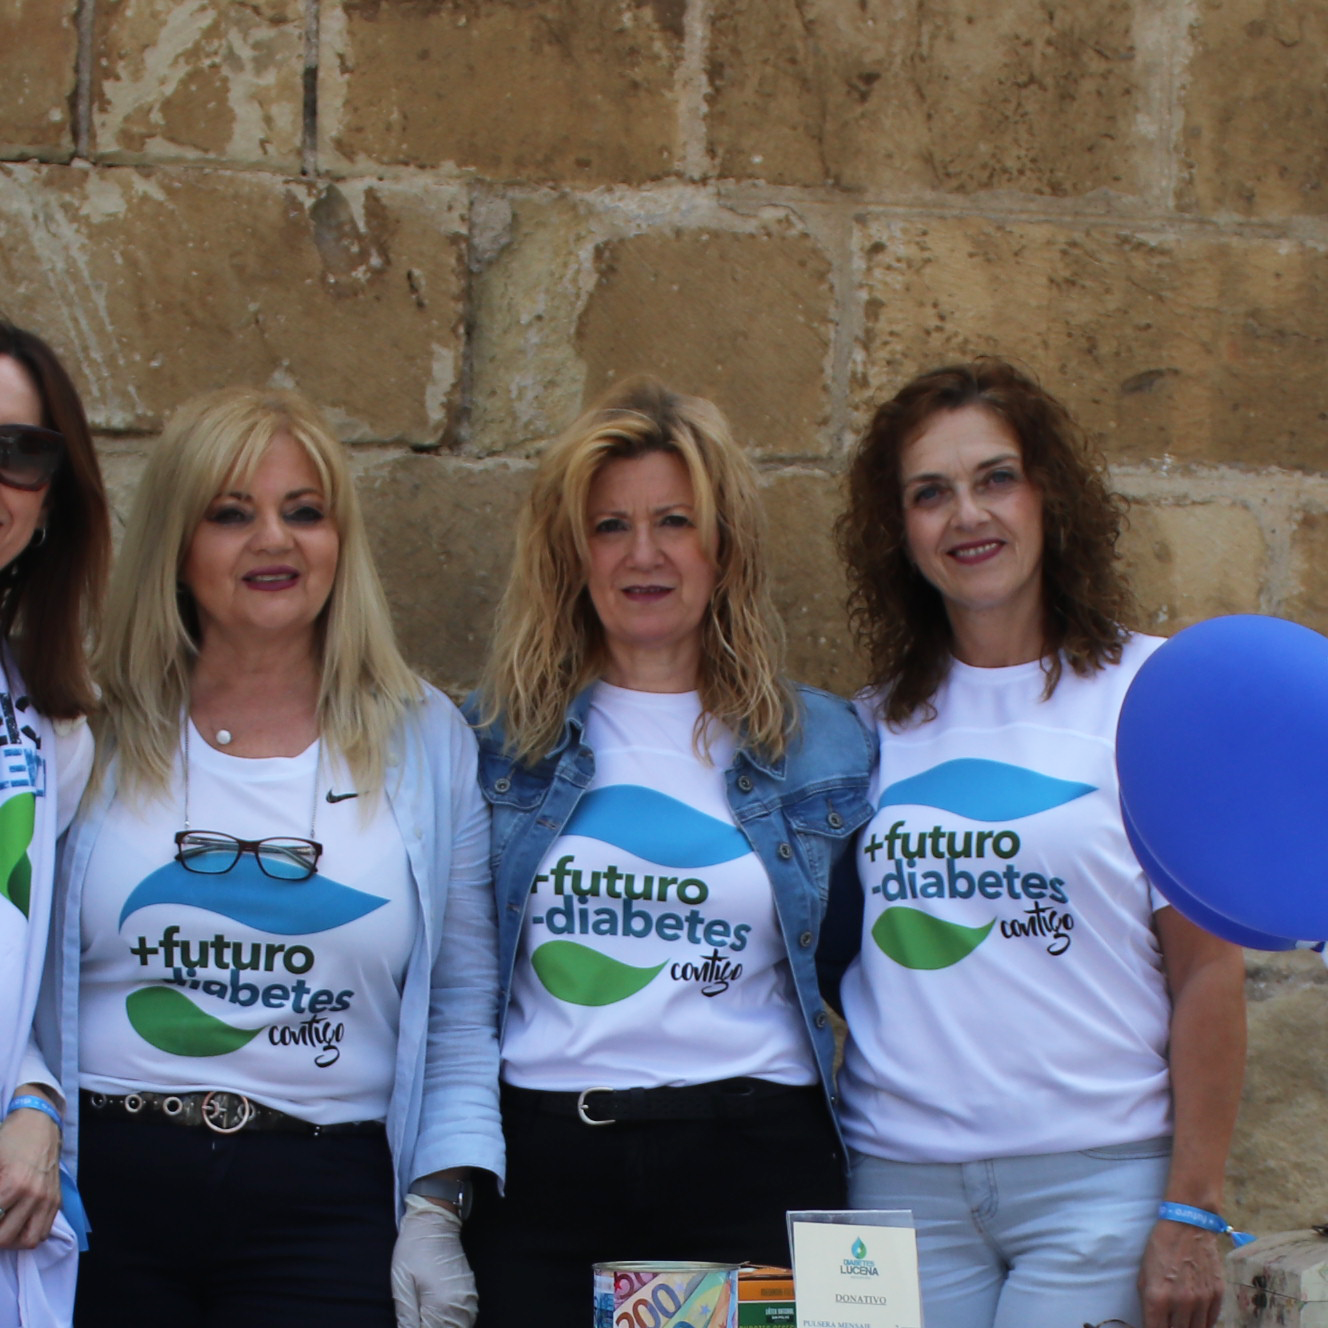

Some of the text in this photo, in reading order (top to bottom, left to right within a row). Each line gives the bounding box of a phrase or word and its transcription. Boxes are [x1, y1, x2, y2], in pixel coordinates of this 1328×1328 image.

[864, 820, 1020, 862] +futuro
[872, 858, 1069, 904] -diabetes
[532, 894, 752, 952] -diabetes
[1000, 901, 1074, 956] contigo
[130, 925, 315, 975] +futuro
[670, 948, 743, 998] contigo
[268, 1014, 345, 1068] contigo
[840, 1265, 879, 1276] LUCENA
[835, 1293, 887, 1304] DONATIVO
[803, 1319, 836, 1328] PULSERA
